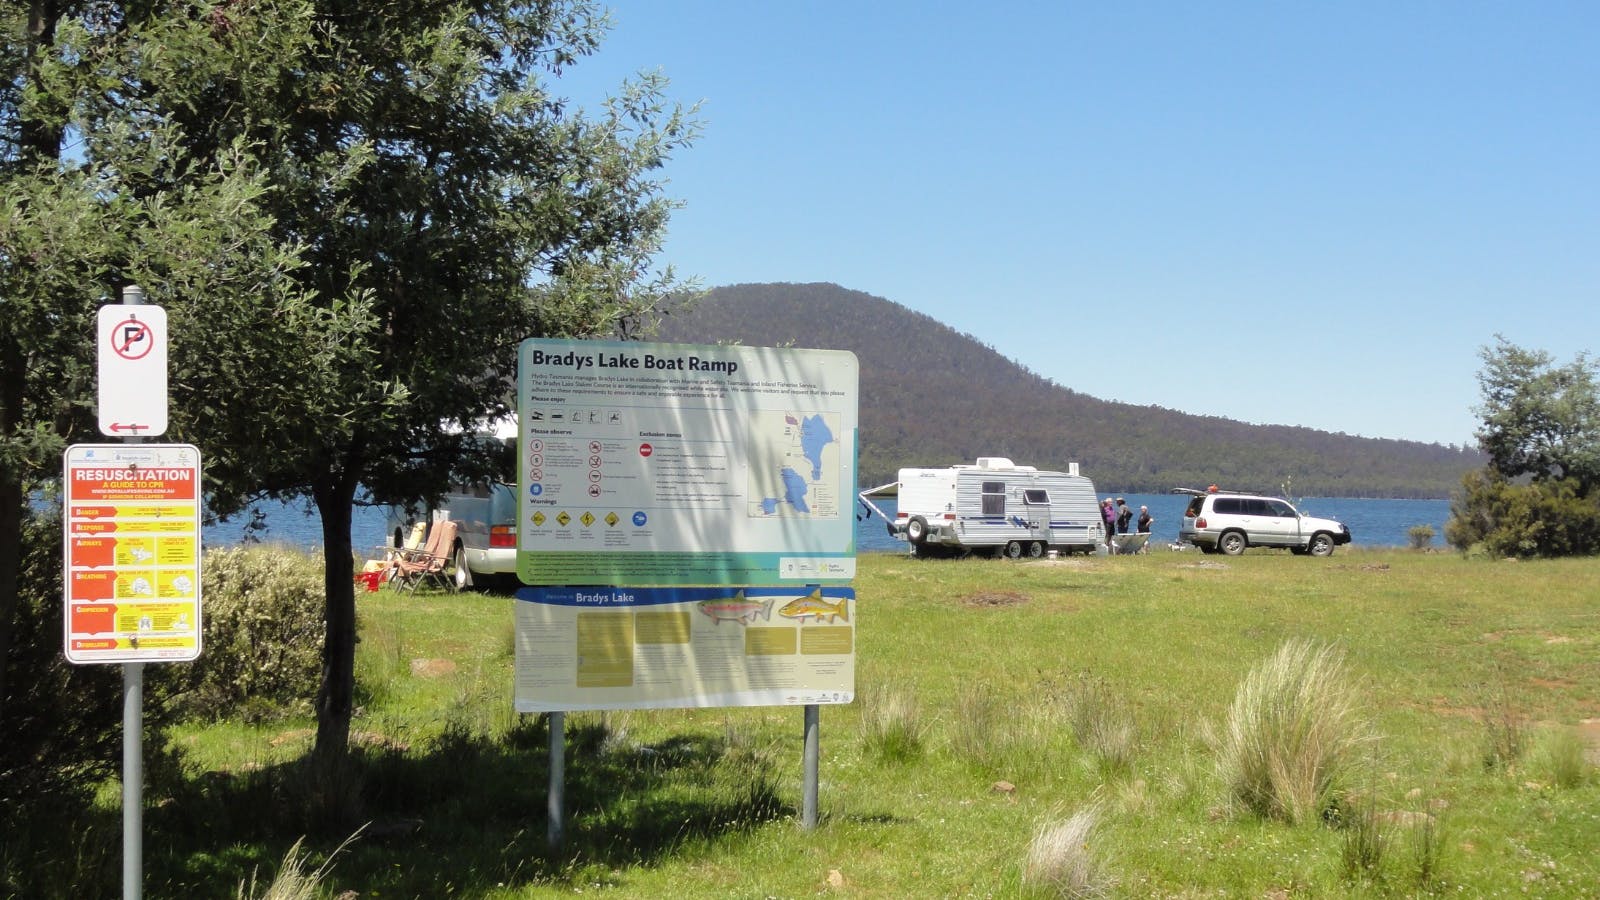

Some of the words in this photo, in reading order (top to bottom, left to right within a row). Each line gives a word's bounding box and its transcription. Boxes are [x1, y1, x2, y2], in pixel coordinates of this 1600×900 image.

[532, 350, 594, 370] Bradys
[599, 353, 640, 369] Lake
[644, 354, 684, 370] Boat
[689, 356, 738, 375] Ramp
[76, 469, 190, 481] RESUSCITATION
[102, 481, 109, 489] A
[110, 481, 135, 489] GUIDE
[136, 481, 147, 489] TO
[148, 481, 164, 489] CPR
[576, 592, 609, 605] Bradys
[612, 592, 635, 602] Lake
